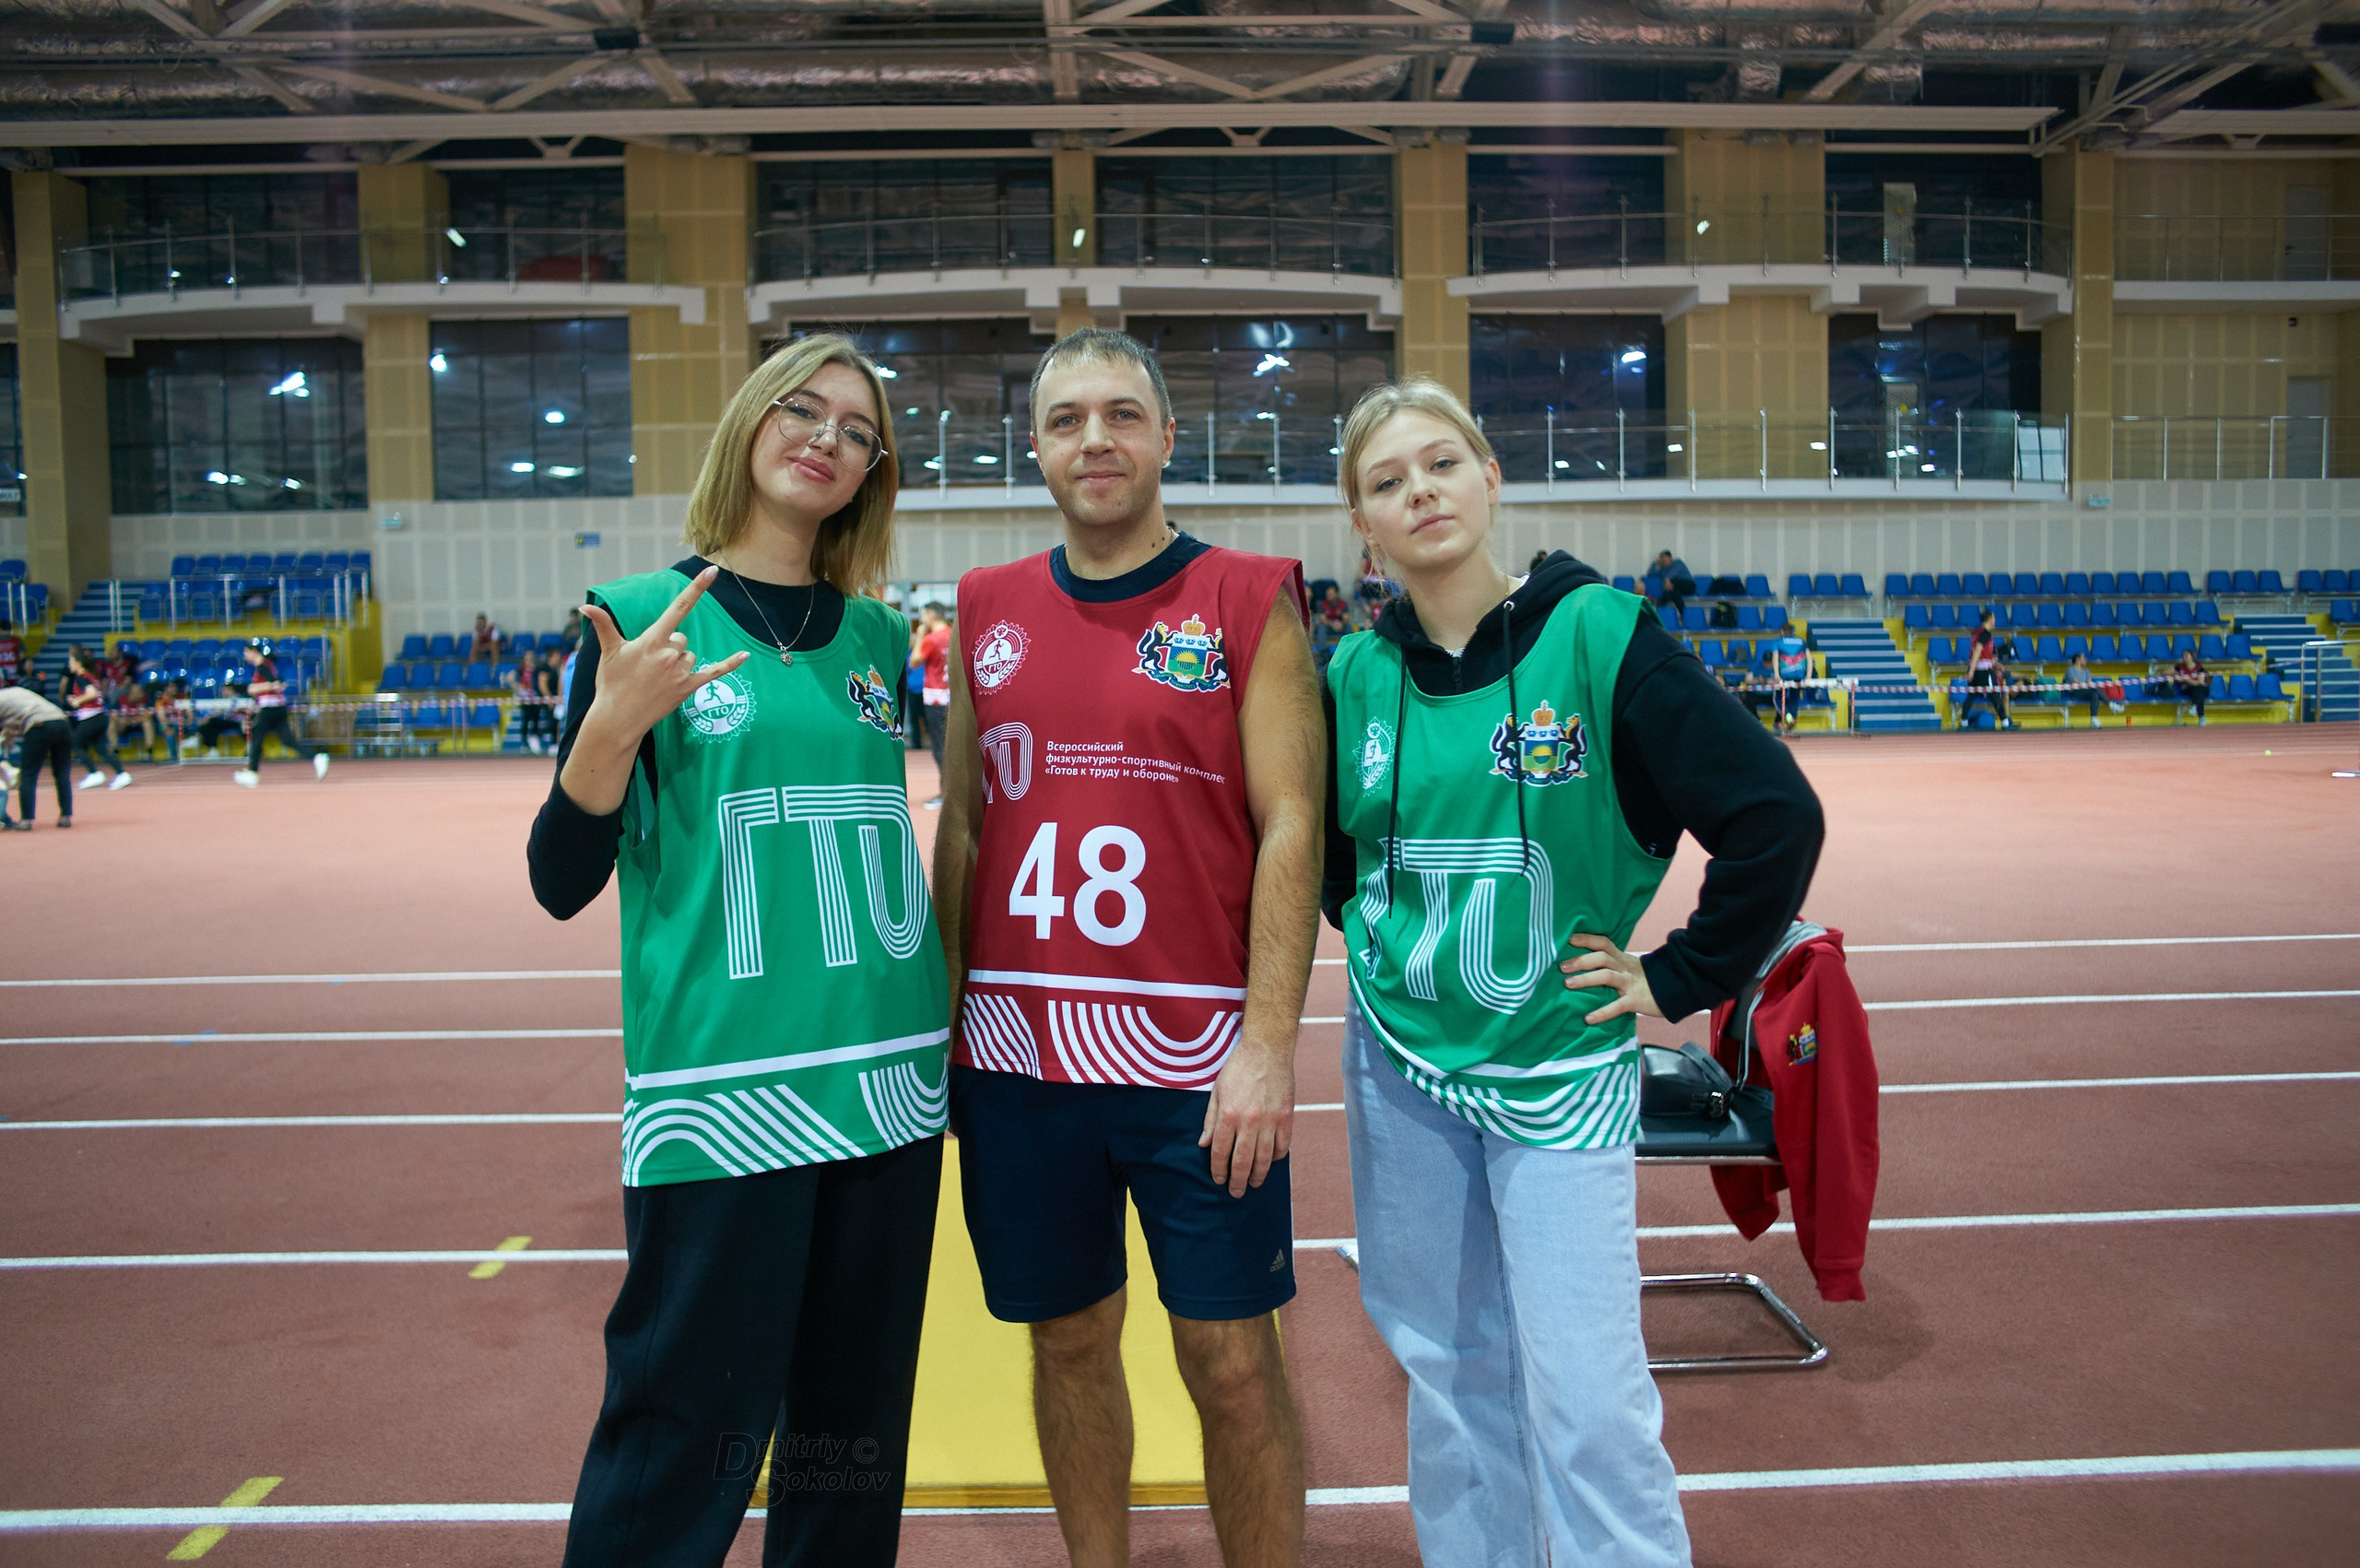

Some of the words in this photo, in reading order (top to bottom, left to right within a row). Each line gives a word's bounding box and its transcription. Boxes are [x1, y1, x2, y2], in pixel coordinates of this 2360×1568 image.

[988, 662, 1003, 673] ГТО
[707, 706, 729, 718] ГТО
[1046, 741, 1124, 752] Всероссийский
[1045, 754, 1181, 772] физкультурно-спортивный
[1044, 765, 1079, 775] «Готов
[1089, 768, 1119, 778] труду
[1132, 770, 1178, 783] обороне»
[718, 784, 928, 979] ГТО
[1009, 822, 1146, 946] 48
